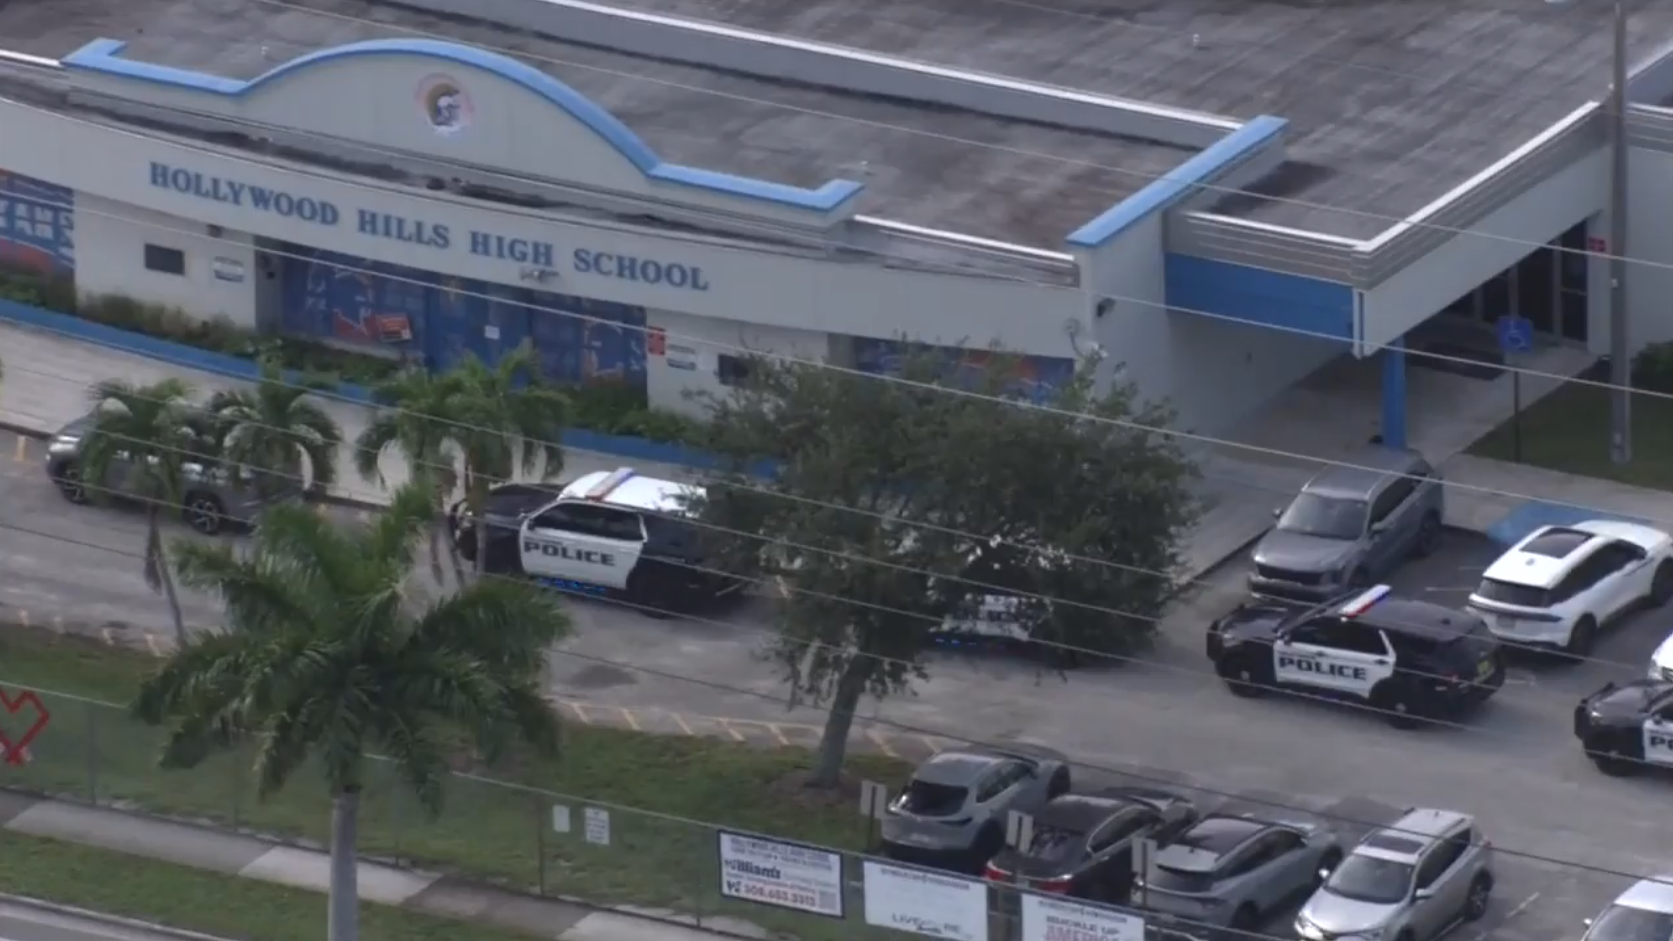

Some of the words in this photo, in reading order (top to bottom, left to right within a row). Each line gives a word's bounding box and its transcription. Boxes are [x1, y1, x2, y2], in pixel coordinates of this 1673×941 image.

[148, 161, 339, 226] HOLLYWOOD
[357, 208, 450, 249] HILLS
[469, 230, 554, 267] HIGH
[572, 247, 709, 291] SCHOOL
[523, 541, 616, 567] POLICE
[1279, 657, 1367, 681] POLICE
